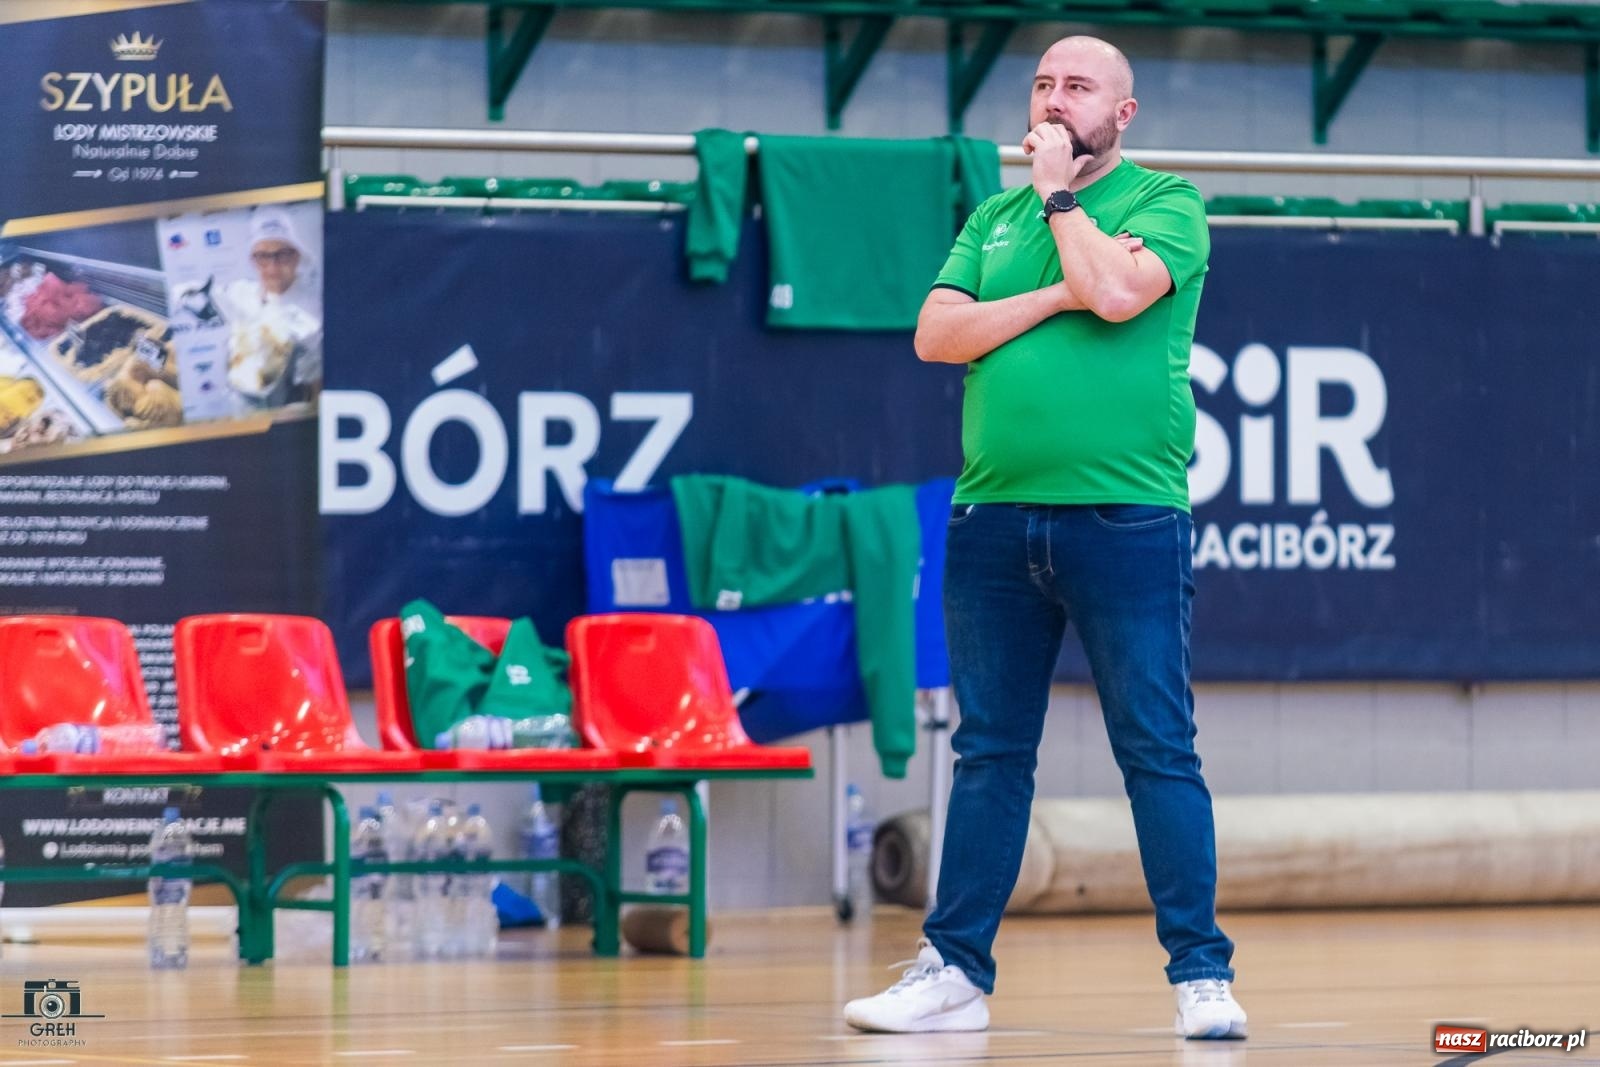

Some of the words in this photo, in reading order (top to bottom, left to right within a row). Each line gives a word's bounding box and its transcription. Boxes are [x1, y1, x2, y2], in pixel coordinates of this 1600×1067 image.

[40, 72, 233, 112] SZYPUŁA
[54, 124, 97, 141] LODY
[99, 124, 218, 142] MISTRZOWSKIE
[1191, 510, 1396, 569] ACIBÓRZ
